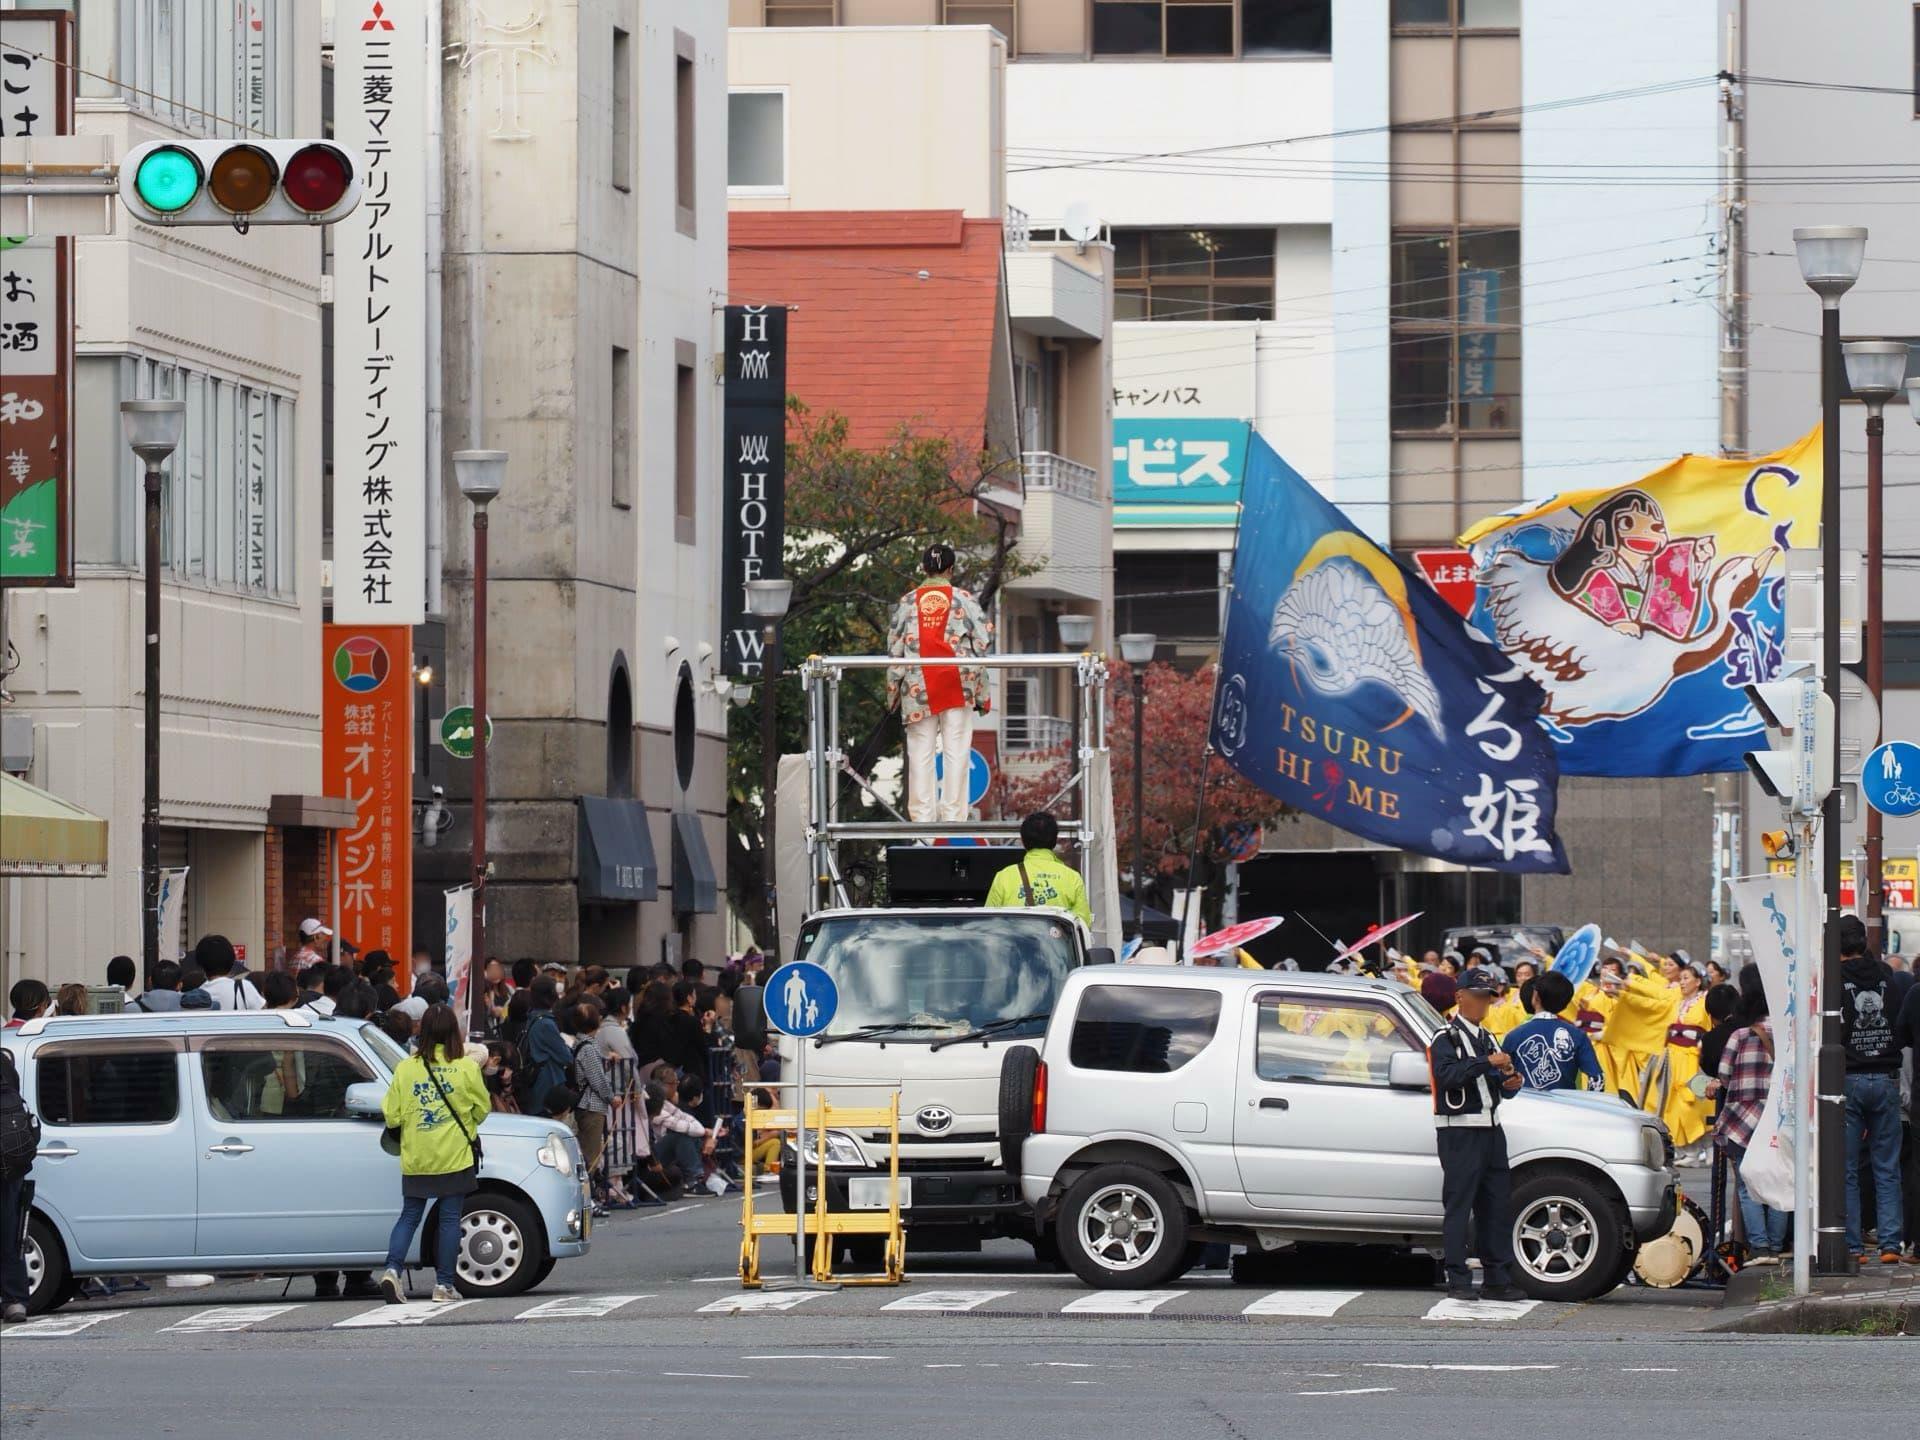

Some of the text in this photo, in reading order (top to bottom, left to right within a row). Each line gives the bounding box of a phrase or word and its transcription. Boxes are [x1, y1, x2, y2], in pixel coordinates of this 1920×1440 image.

[0, 270, 38, 352] お酒
[362, 42, 398, 604] 三菱マテリアルトレーディング株式会社
[1281, 703, 1403, 775] TSURU
[344, 741, 376, 943] オレンジホー
